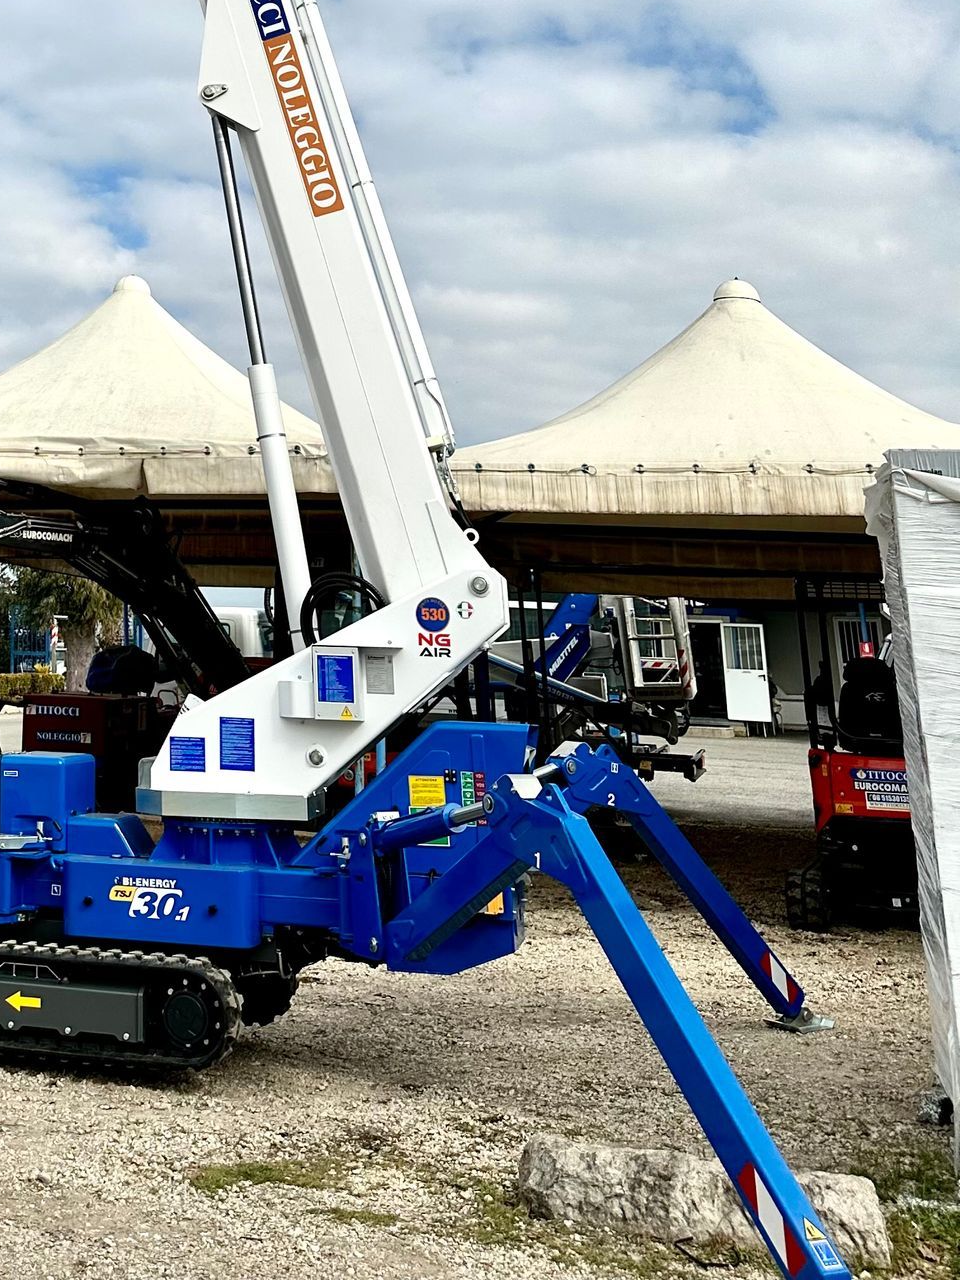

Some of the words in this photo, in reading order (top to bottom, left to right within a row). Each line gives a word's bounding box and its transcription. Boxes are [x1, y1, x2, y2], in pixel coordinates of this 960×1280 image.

[267, 39, 338, 209] NOLEGGIO
[22, 530, 74, 542] EUROCOMACH
[421, 608, 447, 621] 530
[418, 632, 451, 647] NG
[419, 647, 451, 658] AIR
[548, 636, 579, 676] MULTITEL
[37, 705, 80, 716] TITOCCI
[37, 731, 81, 741] NOLEGGIO
[854, 781, 908, 792] EUROCOMA
[607, 793, 616, 807] 2
[534, 852, 540, 869] 1
[122, 877, 177, 888] BI-ENERGY
[114, 889, 132, 898] TSJ
